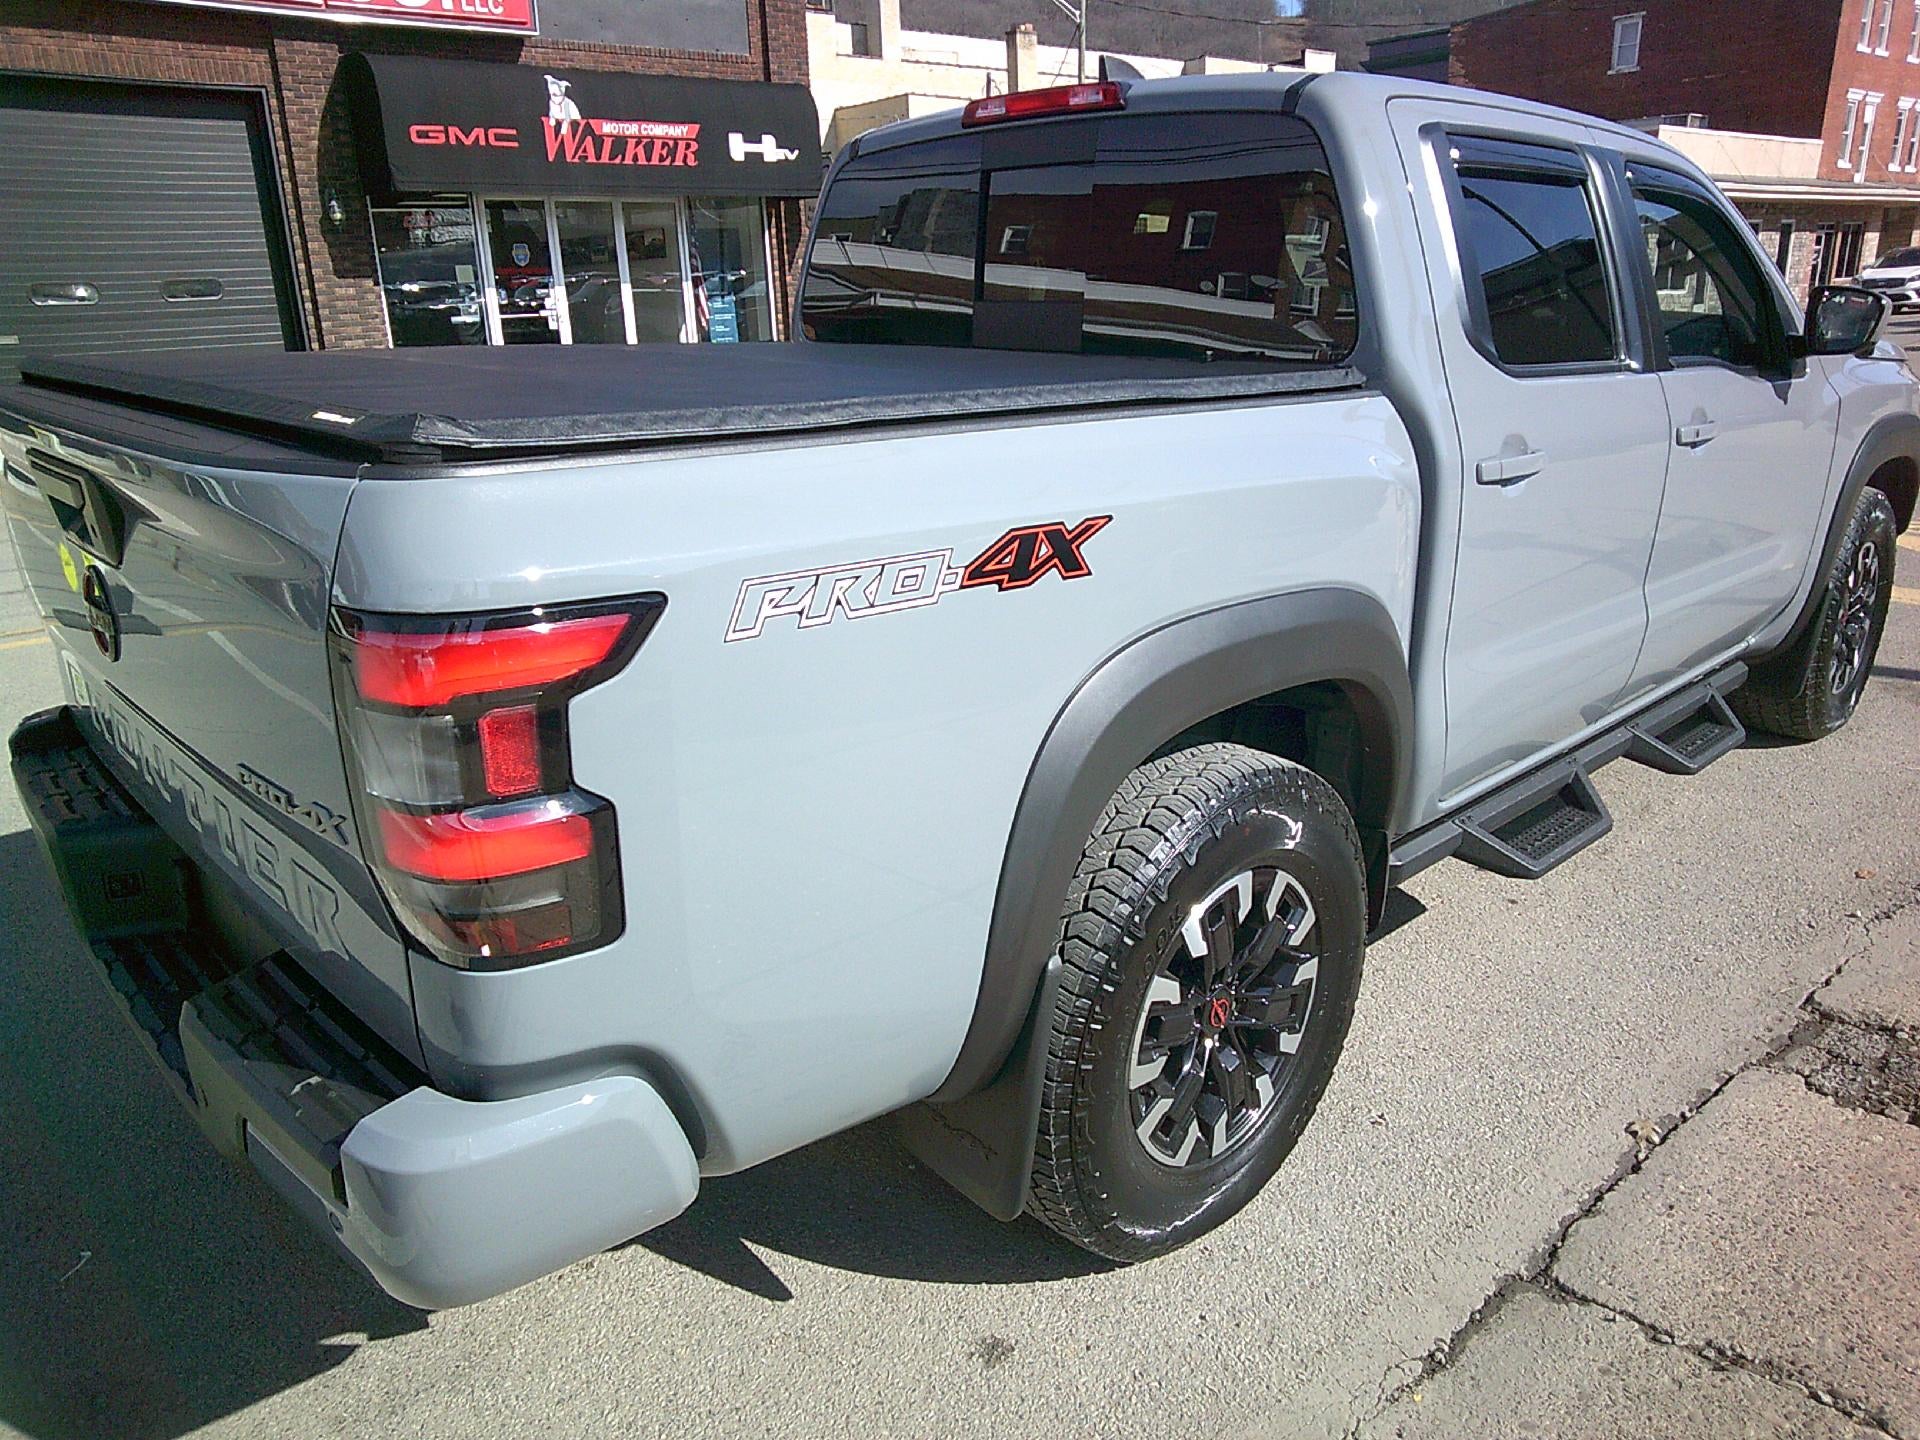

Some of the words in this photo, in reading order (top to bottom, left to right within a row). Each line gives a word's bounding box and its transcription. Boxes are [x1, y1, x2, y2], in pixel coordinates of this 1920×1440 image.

[409, 124, 519, 147] GMC
[602, 121, 638, 135] MOTOR
[640, 123, 689, 136] COMPANY
[541, 116, 699, 166] WALKER
